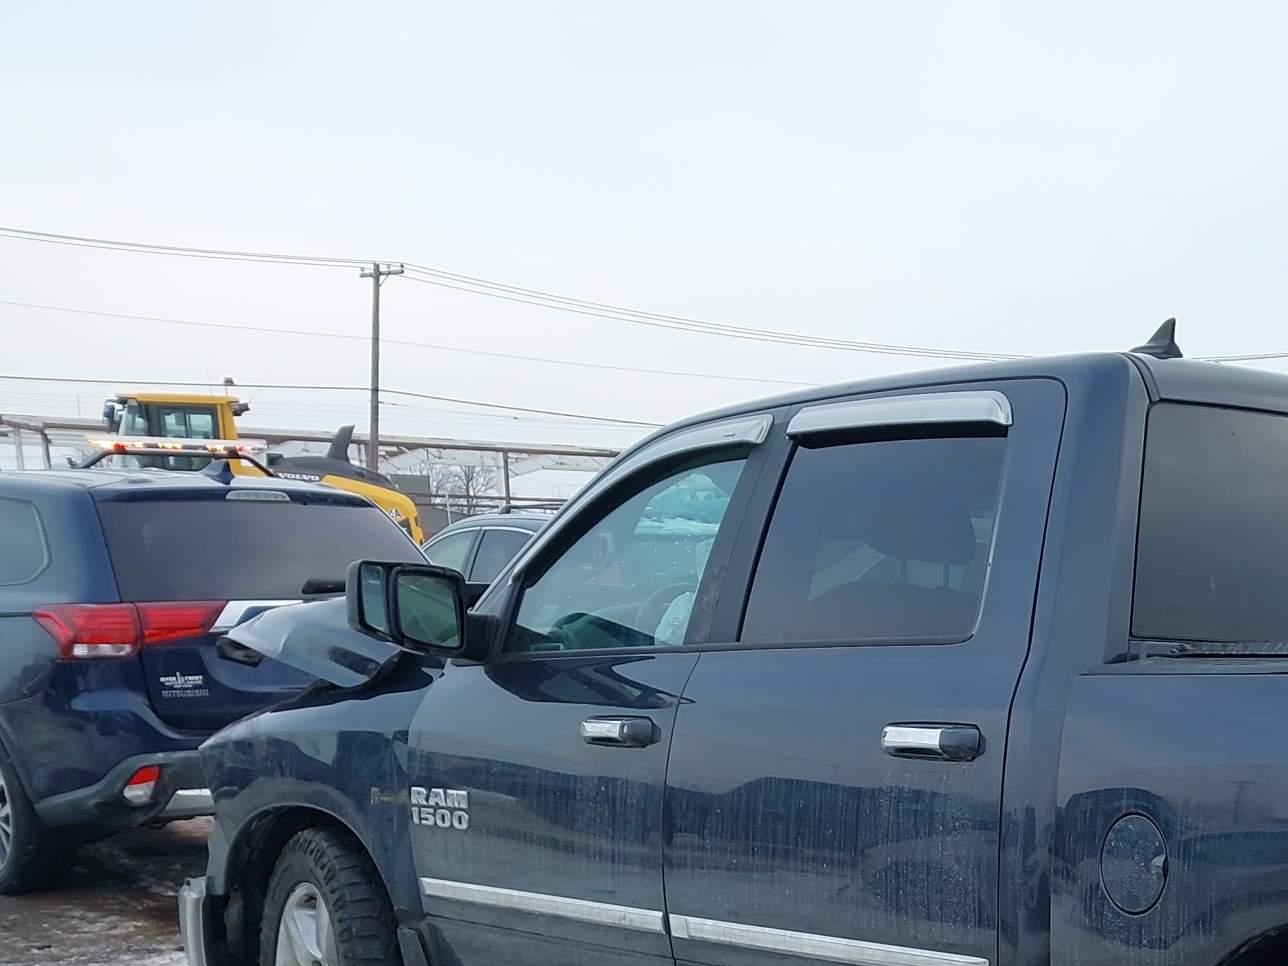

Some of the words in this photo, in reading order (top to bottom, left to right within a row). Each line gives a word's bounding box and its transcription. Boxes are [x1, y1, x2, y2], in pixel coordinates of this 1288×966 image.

[278, 472, 320, 481] VOLVO
[410, 787, 468, 808] RAM
[411, 806, 469, 830] 1500
